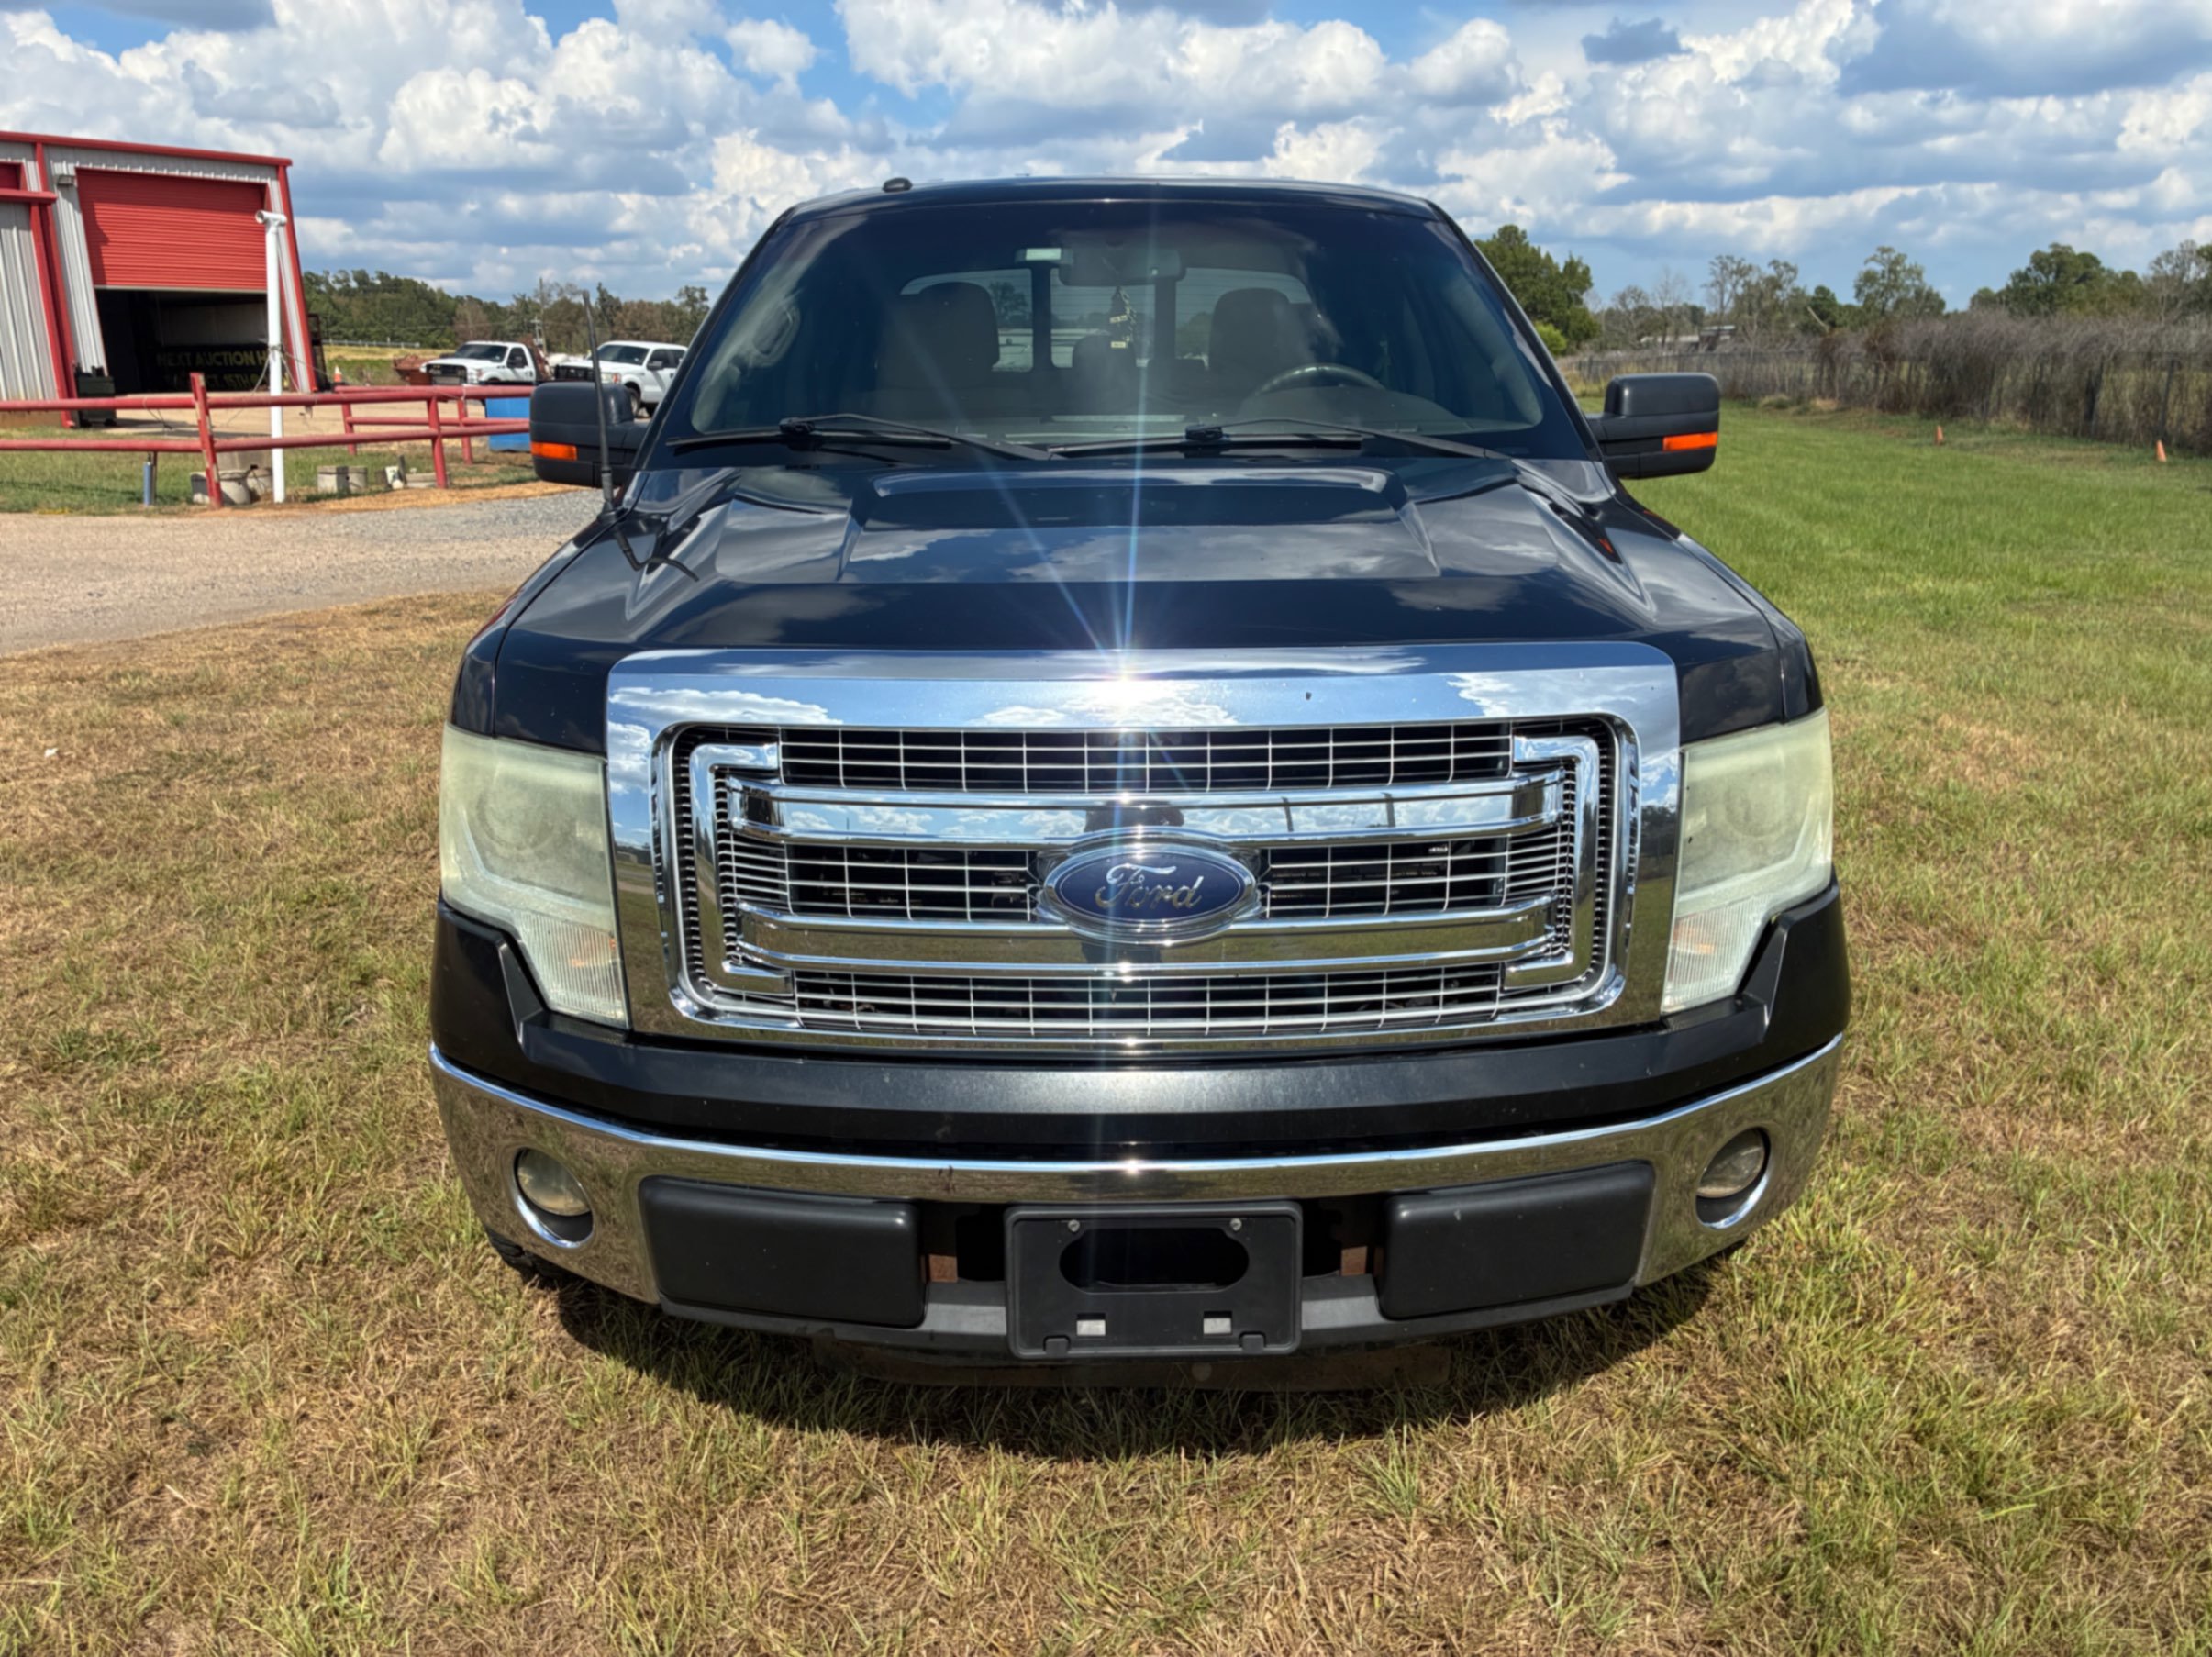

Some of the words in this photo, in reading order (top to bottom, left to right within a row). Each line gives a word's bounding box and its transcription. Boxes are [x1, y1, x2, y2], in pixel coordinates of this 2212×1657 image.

[156, 352, 192, 367] NEXT
[195, 351, 257, 366] AUCTION
[1095, 863, 1204, 908] Ford
